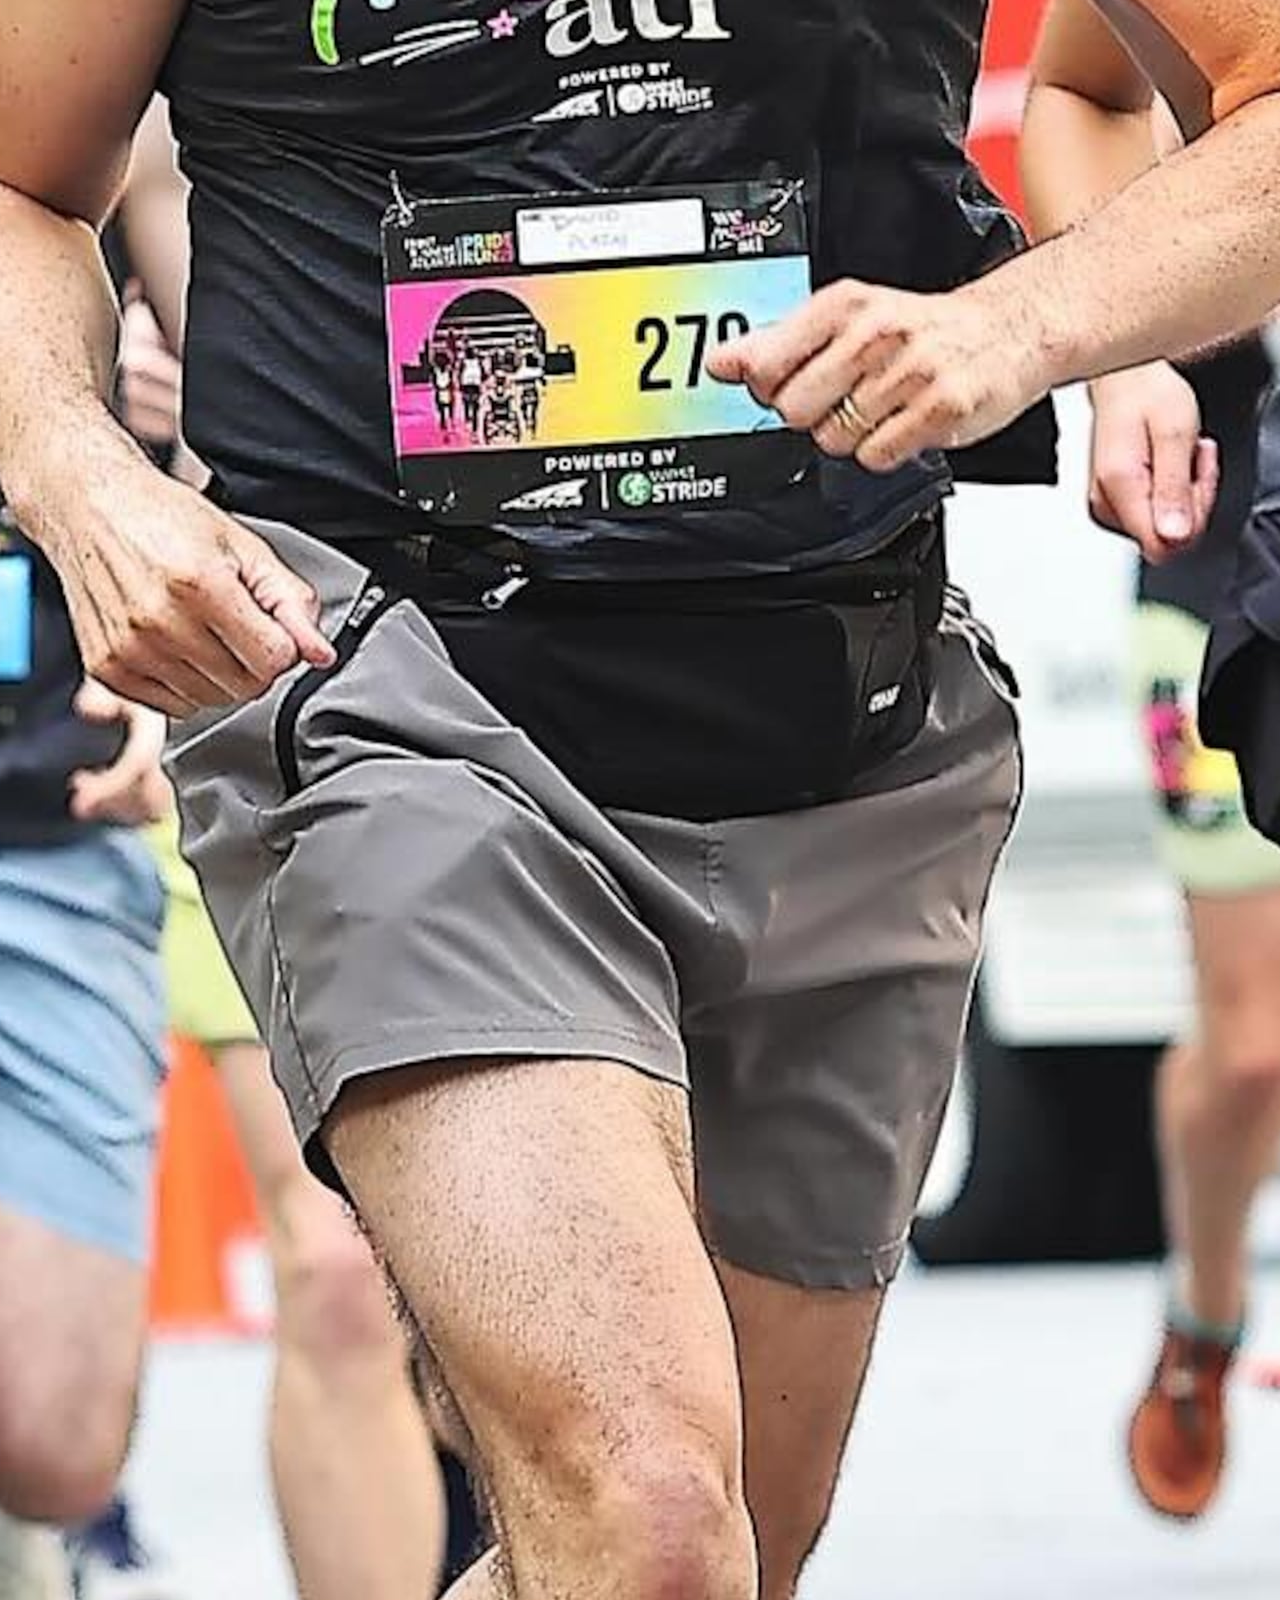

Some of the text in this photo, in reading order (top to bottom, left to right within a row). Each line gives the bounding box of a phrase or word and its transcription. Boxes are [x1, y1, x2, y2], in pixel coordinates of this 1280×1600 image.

[545, 447, 677, 474] POWERED BY
[651, 476, 727, 503] STRIDE
